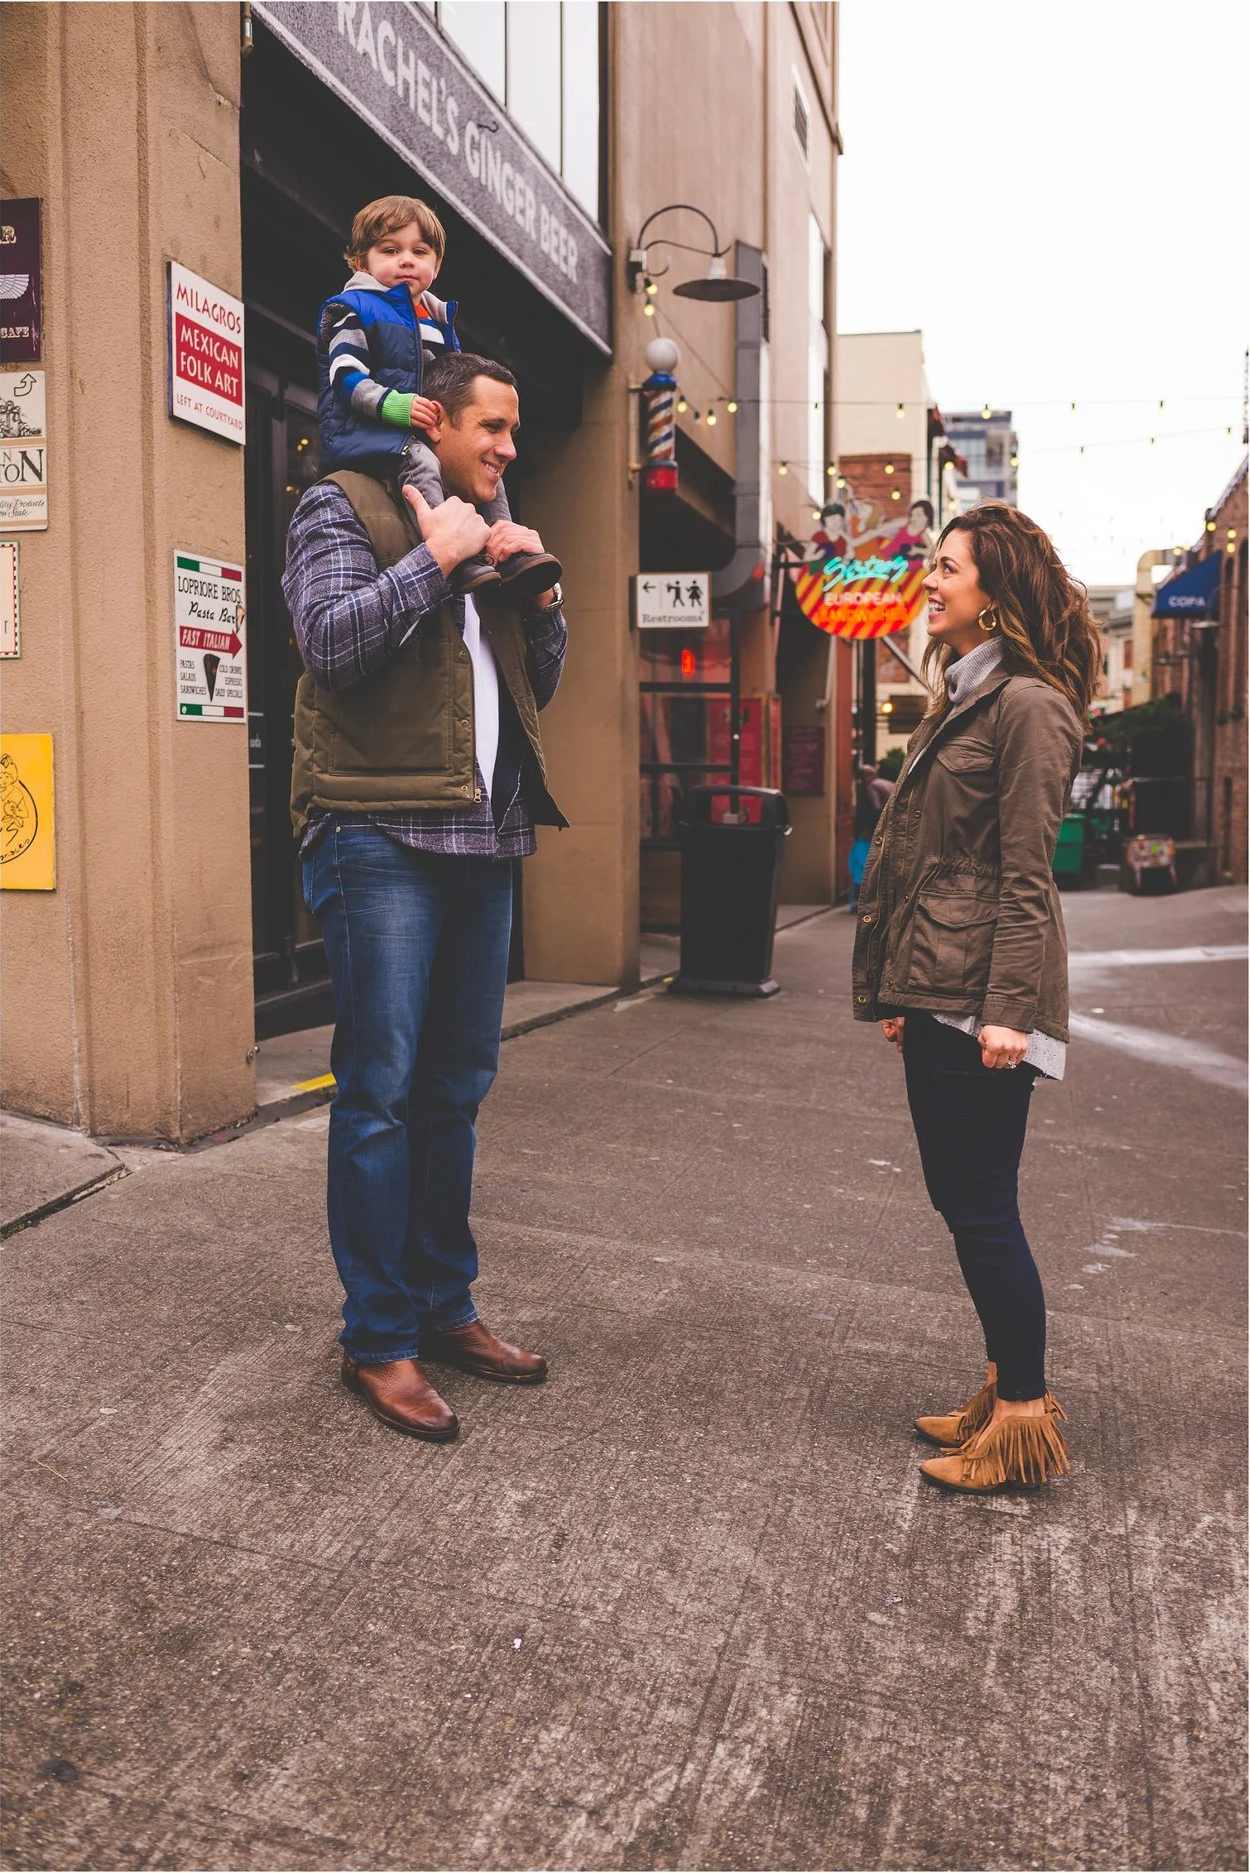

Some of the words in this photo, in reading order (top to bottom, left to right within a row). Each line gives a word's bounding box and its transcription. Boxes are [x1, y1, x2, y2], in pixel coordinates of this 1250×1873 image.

[465, 120, 536, 241] GINGER
[539, 203, 578, 284] BEER
[176, 282, 241, 334] MILAGROS
[180, 323, 239, 370] MEXICAN
[180, 351, 211, 385] FOLK
[214, 370, 239, 397] ART
[176, 393, 191, 408] LEFT
[194, 401, 202, 412] AT
[206, 406, 243, 430] COURTYARD
[178, 576, 218, 600] LOPRIORE
[221, 586, 242, 604] BROS.
[823, 591, 902, 606] EUROPEAN
[188, 601, 214, 620] Pasta
[219, 607, 237, 624] Bar
[642, 614, 703, 624] Restrooms
[182, 629, 200, 646] FAST
[203, 631, 230, 650] ITALIAN
